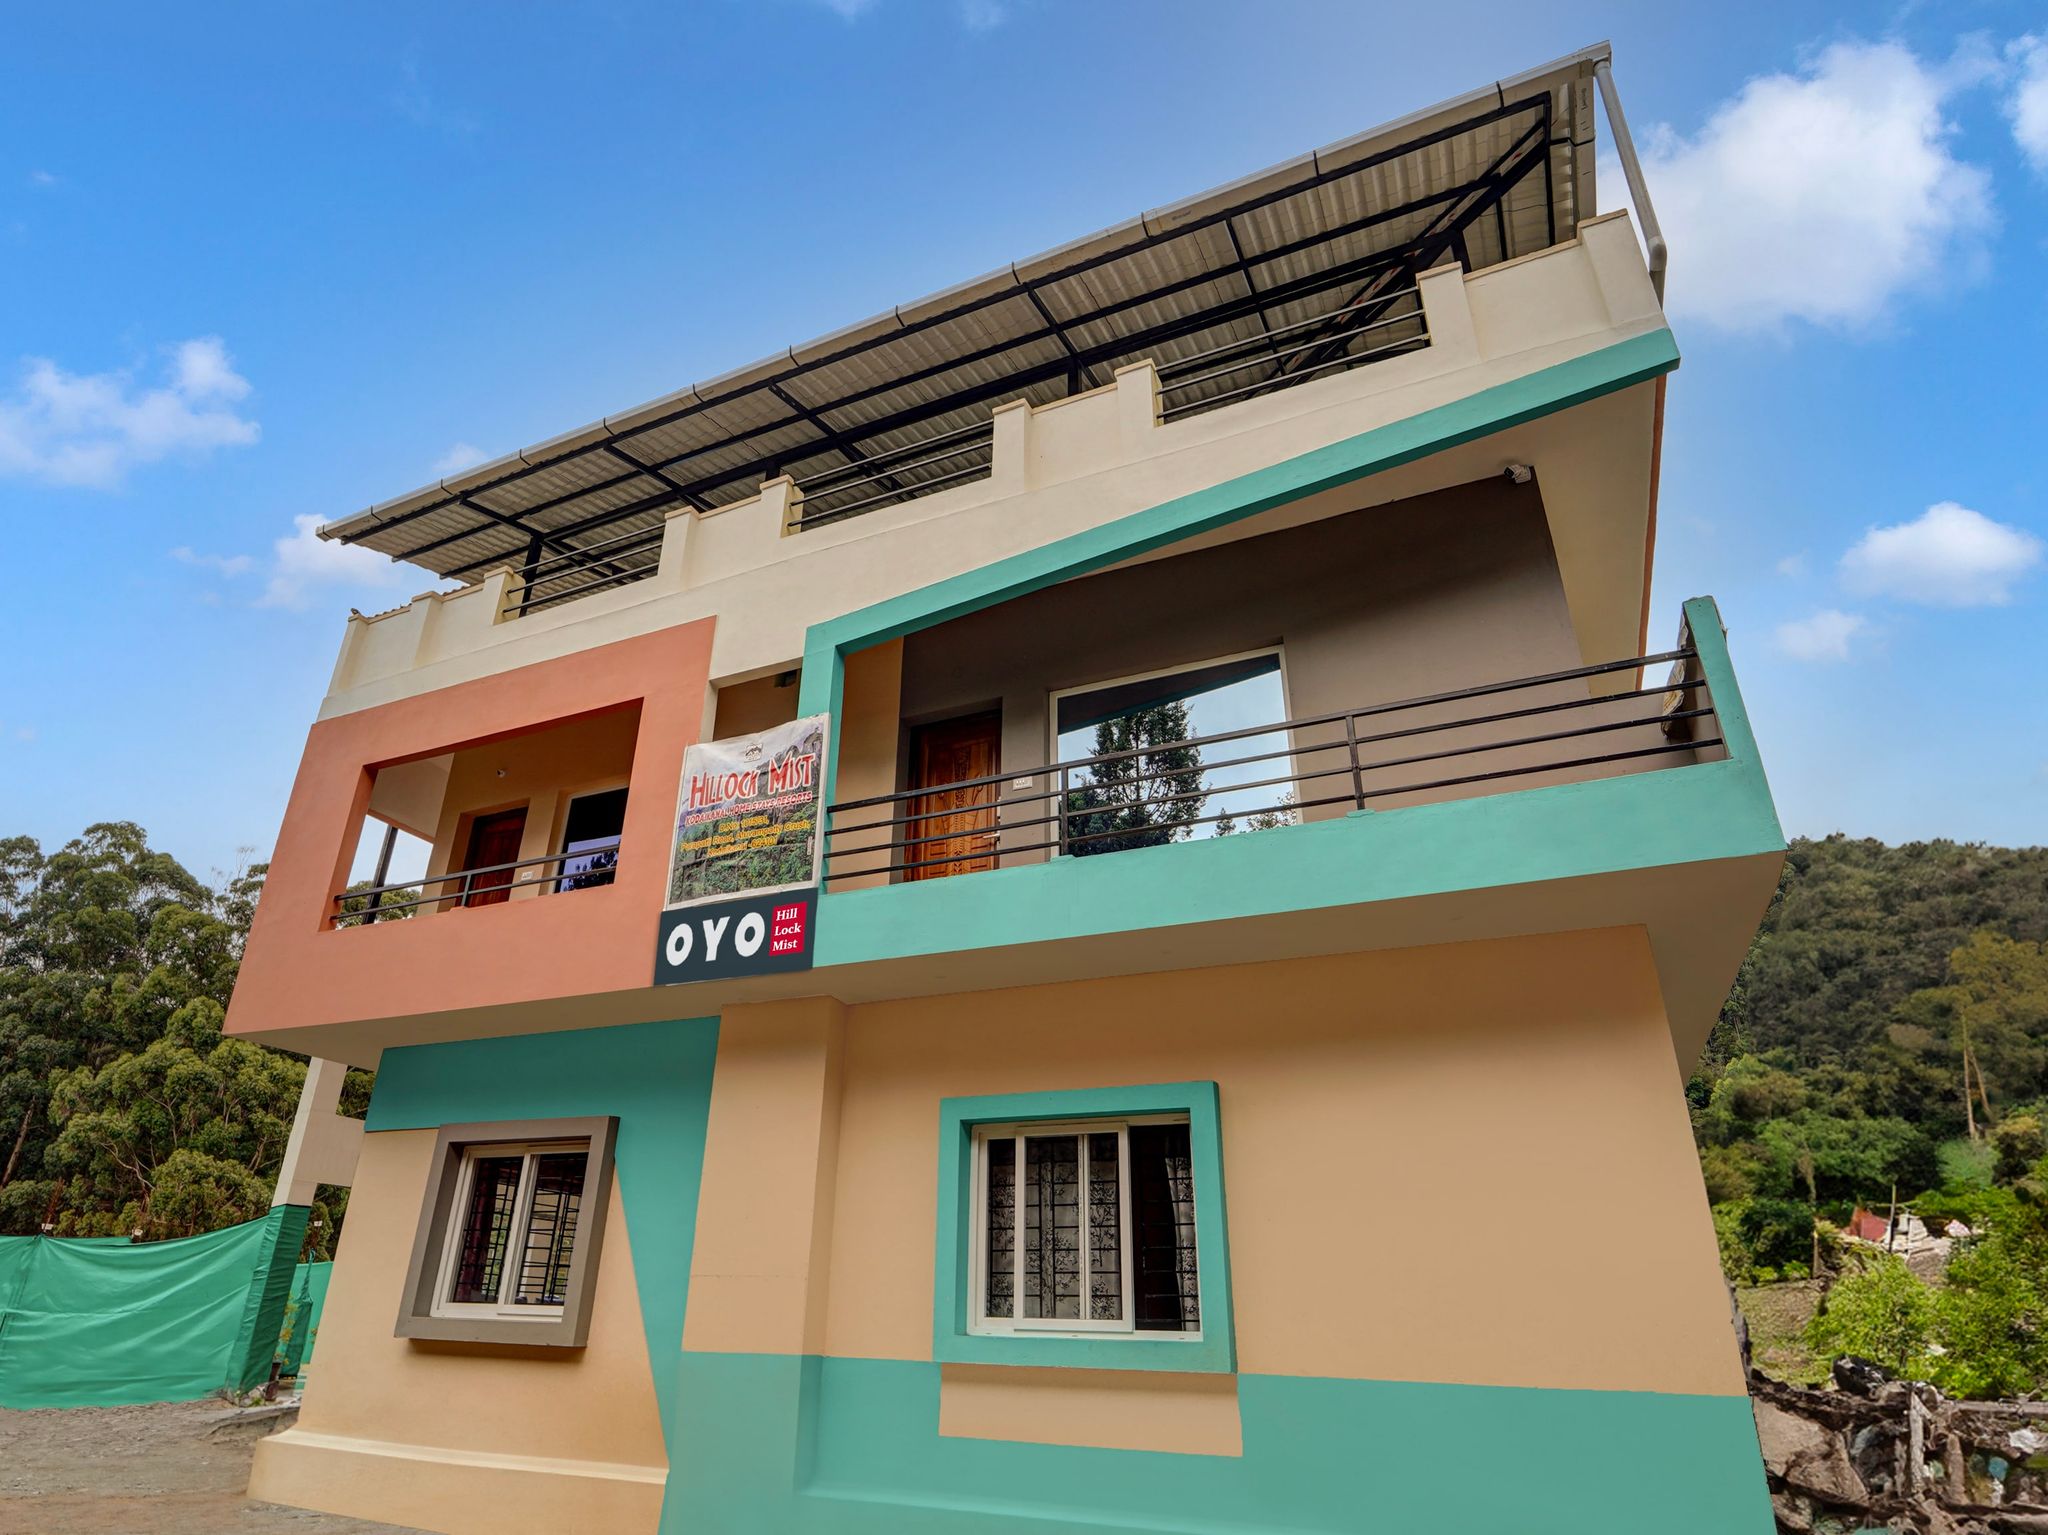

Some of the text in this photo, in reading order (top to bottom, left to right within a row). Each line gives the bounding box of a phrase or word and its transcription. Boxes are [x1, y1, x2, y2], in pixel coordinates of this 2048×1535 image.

[691, 752, 815, 810] HILLOCK MIST
[685, 808, 729, 826] KODAIKANAL
[730, 803, 750, 816] HOME
[776, 908, 798, 921] Hill
[774, 923, 802, 936] Lock
[665, 912, 765, 967] OYO
[772, 939, 798, 951] Mist
